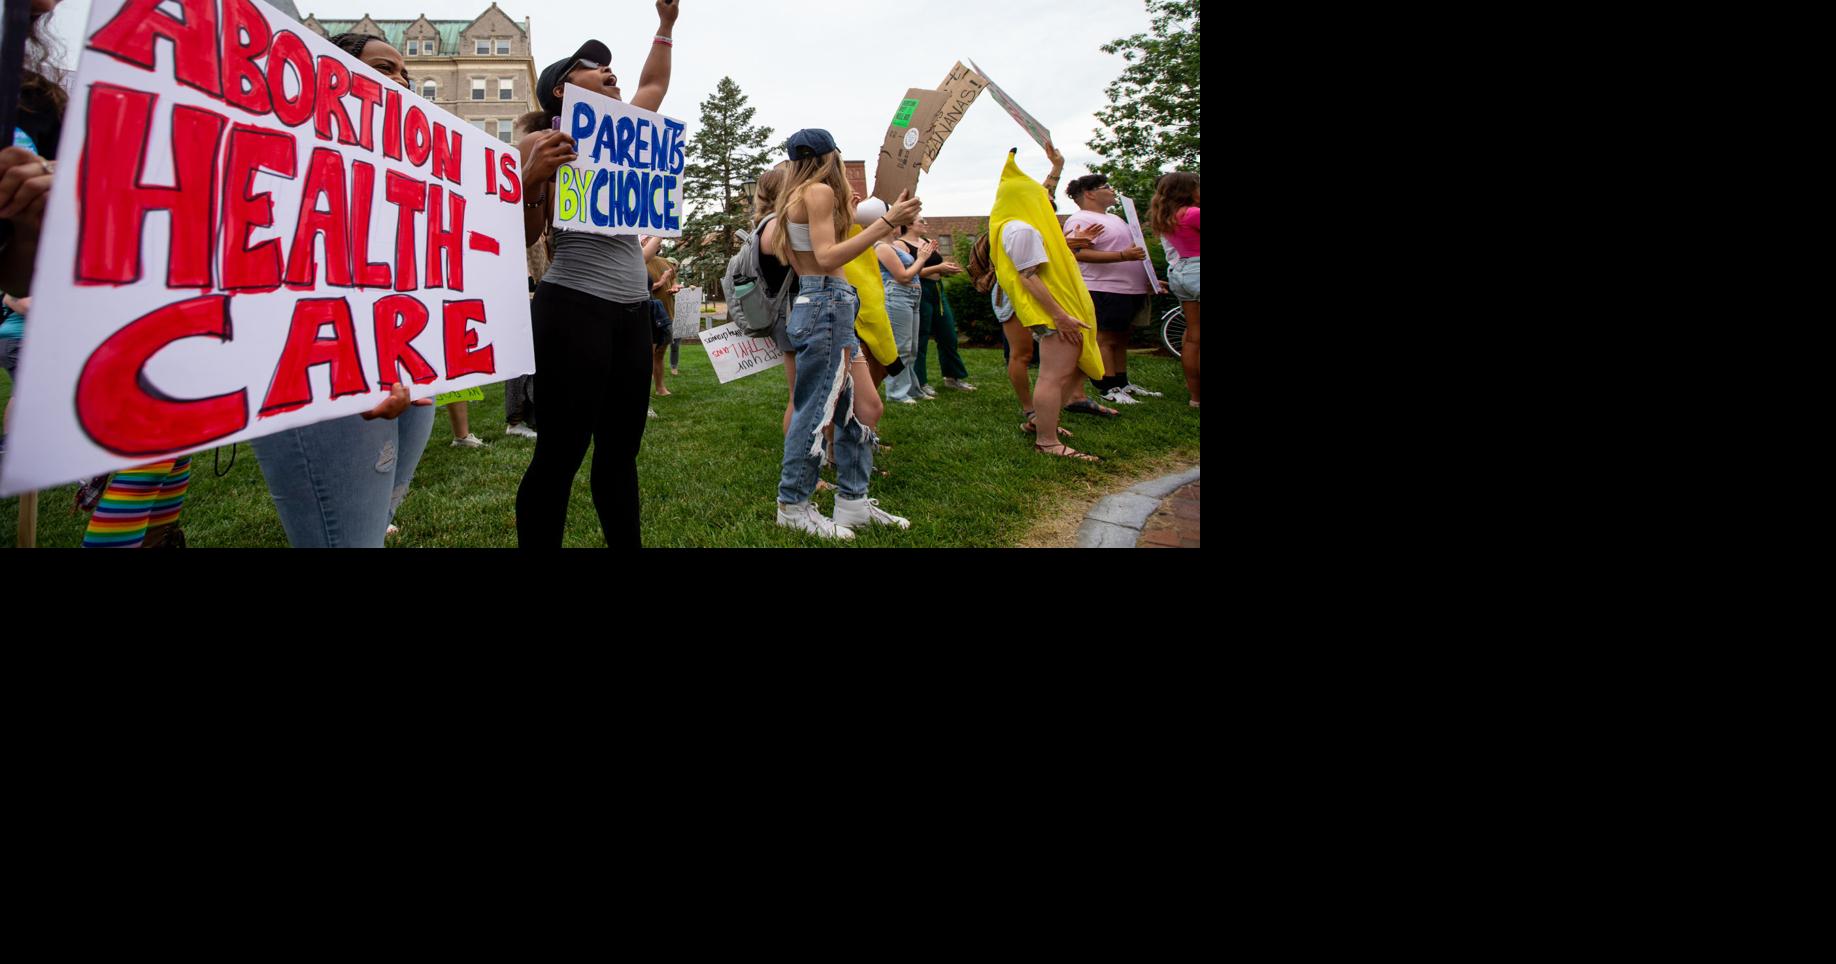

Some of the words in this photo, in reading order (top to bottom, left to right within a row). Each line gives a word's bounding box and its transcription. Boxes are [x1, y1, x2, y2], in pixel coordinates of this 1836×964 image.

[86, 0, 463, 184] ABORTION
[484, 147, 522, 204] IS
[572, 101, 685, 175] PARENTS
[926, 80, 982, 161] BANANAS!
[74, 82, 500, 295] HEALTH-
[559, 164, 595, 223] BY
[590, 168, 680, 231] CHOICE
[75, 294, 496, 459] CARE
